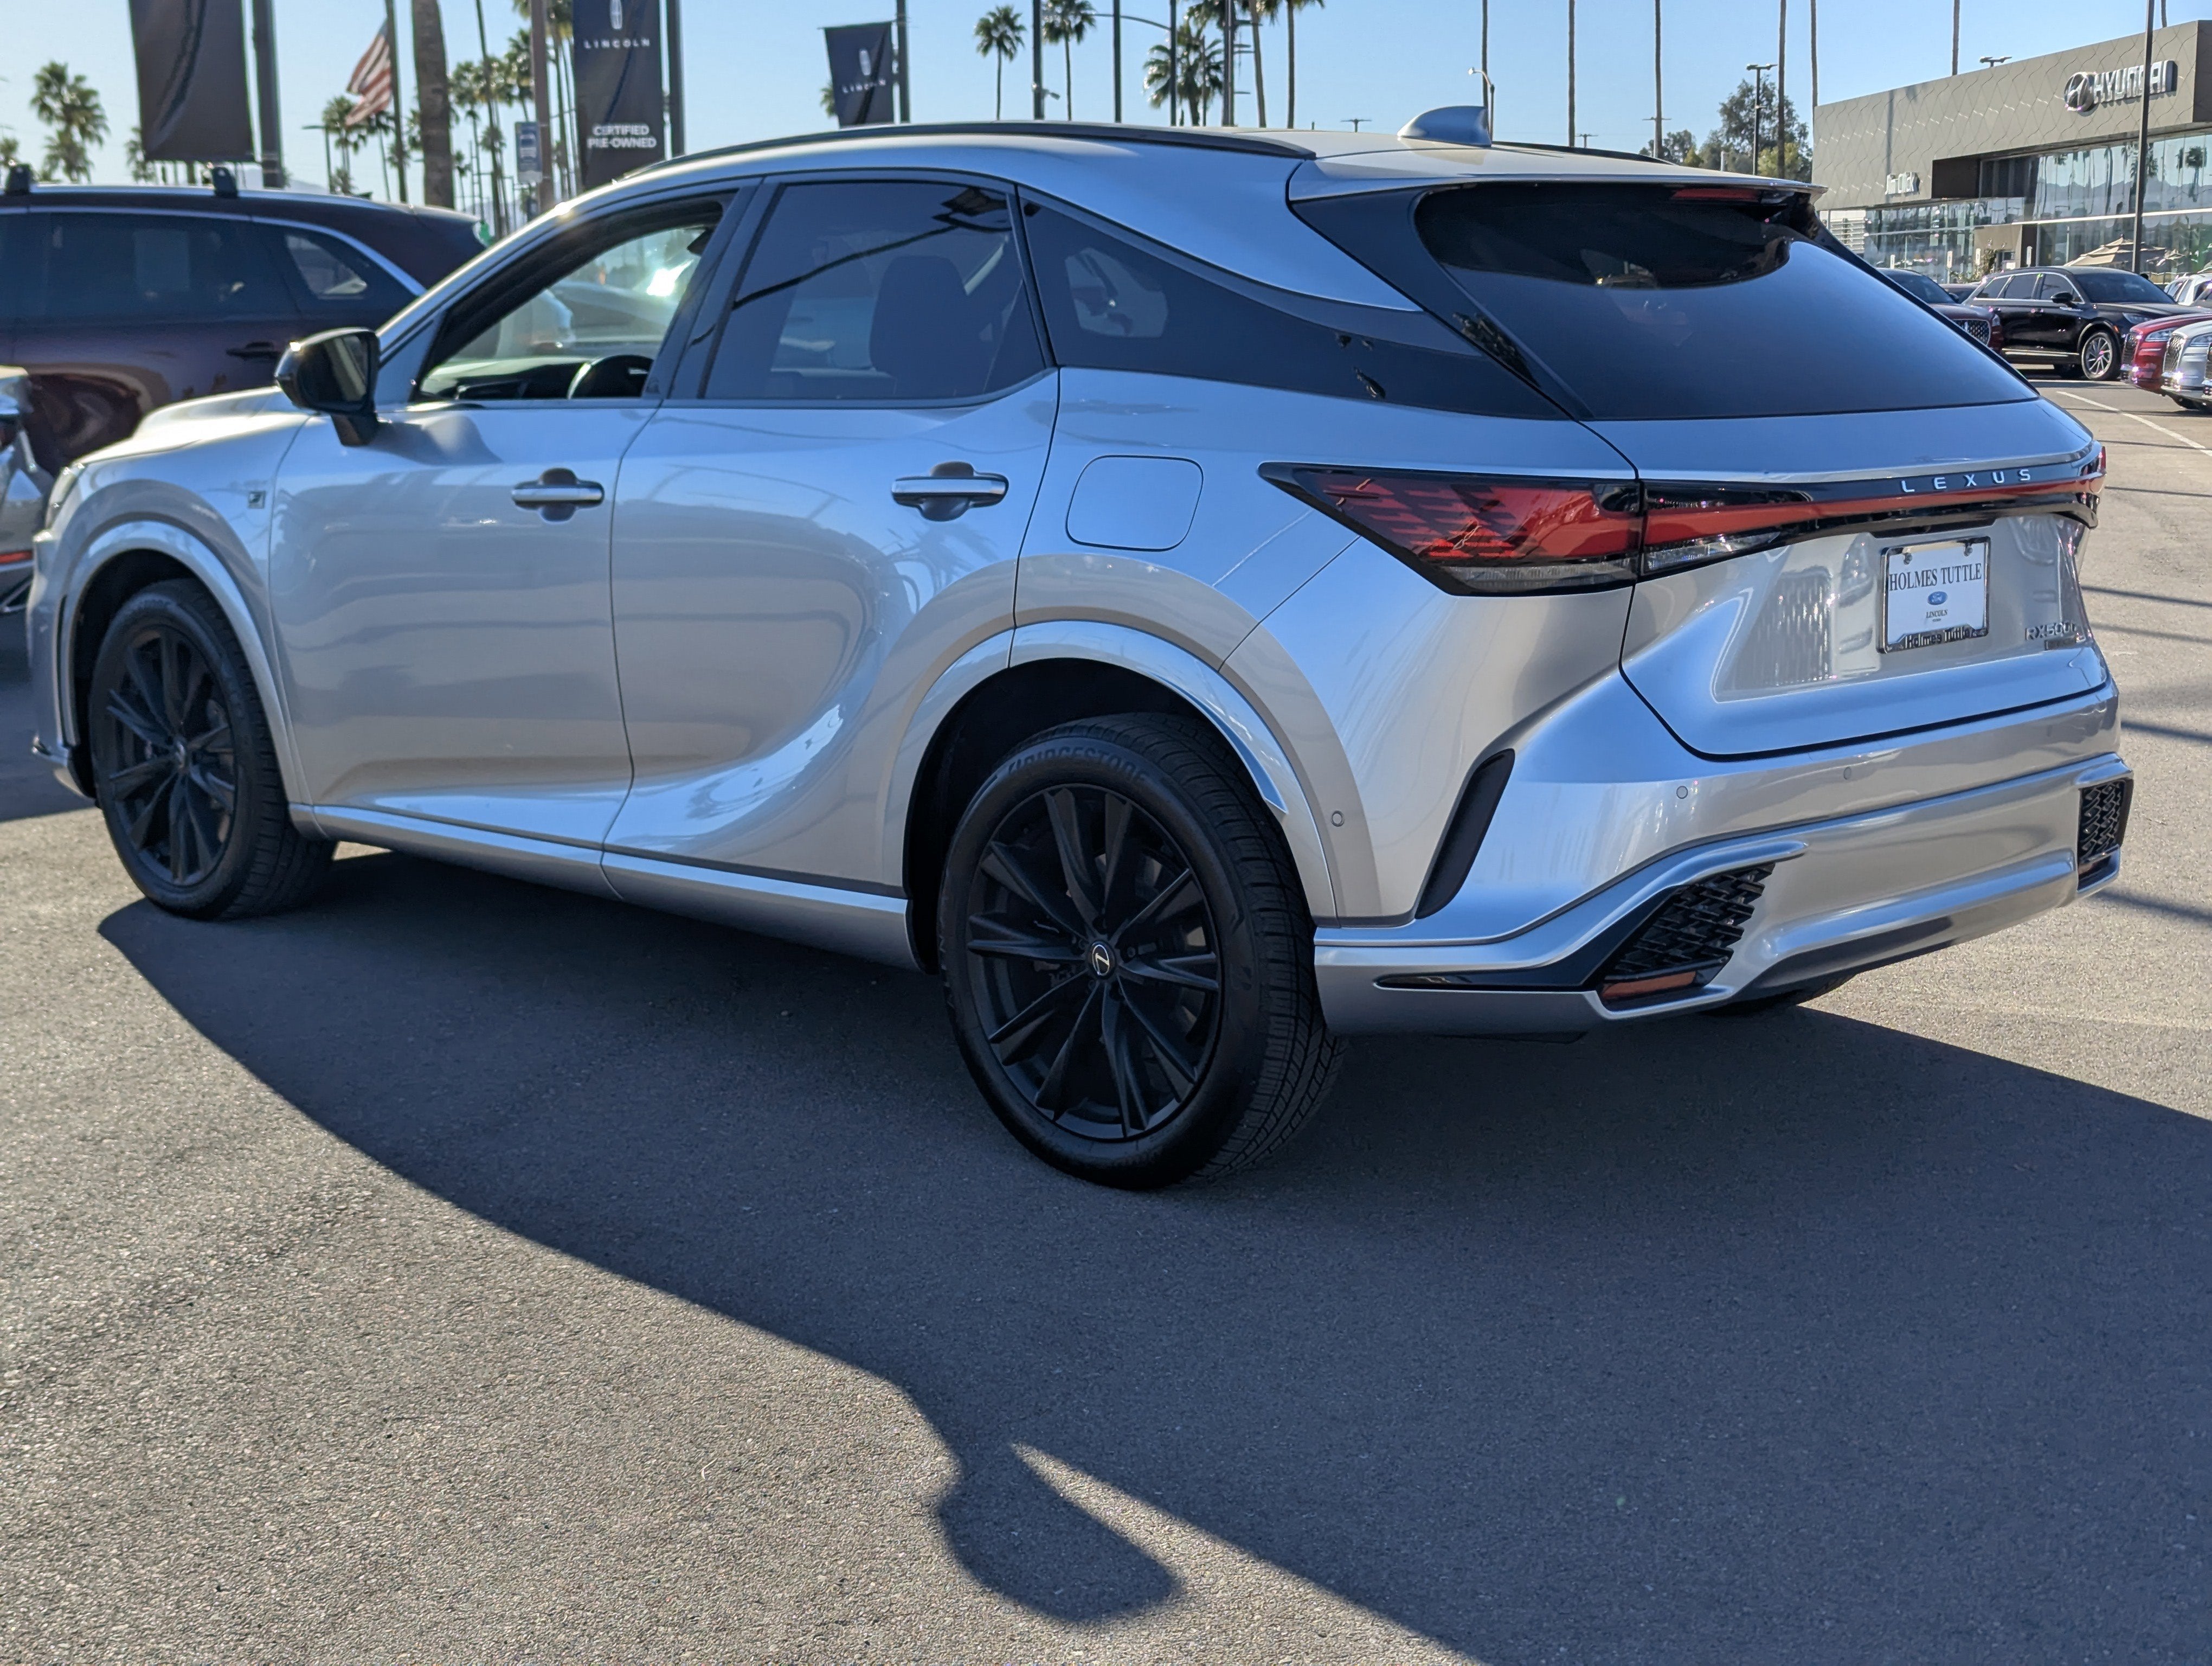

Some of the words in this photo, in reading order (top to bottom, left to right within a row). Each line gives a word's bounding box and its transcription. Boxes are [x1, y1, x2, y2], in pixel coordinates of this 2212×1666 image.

[583, 37, 650, 49] LINCOLN
[593, 124, 650, 135] CERTIFIED
[587, 136, 657, 148] PRE-OWNED
[1901, 469, 2031, 492] LEXUS
[1889, 568, 1938, 591] HOLMES
[1940, 563, 1982, 585] TUTTLE
